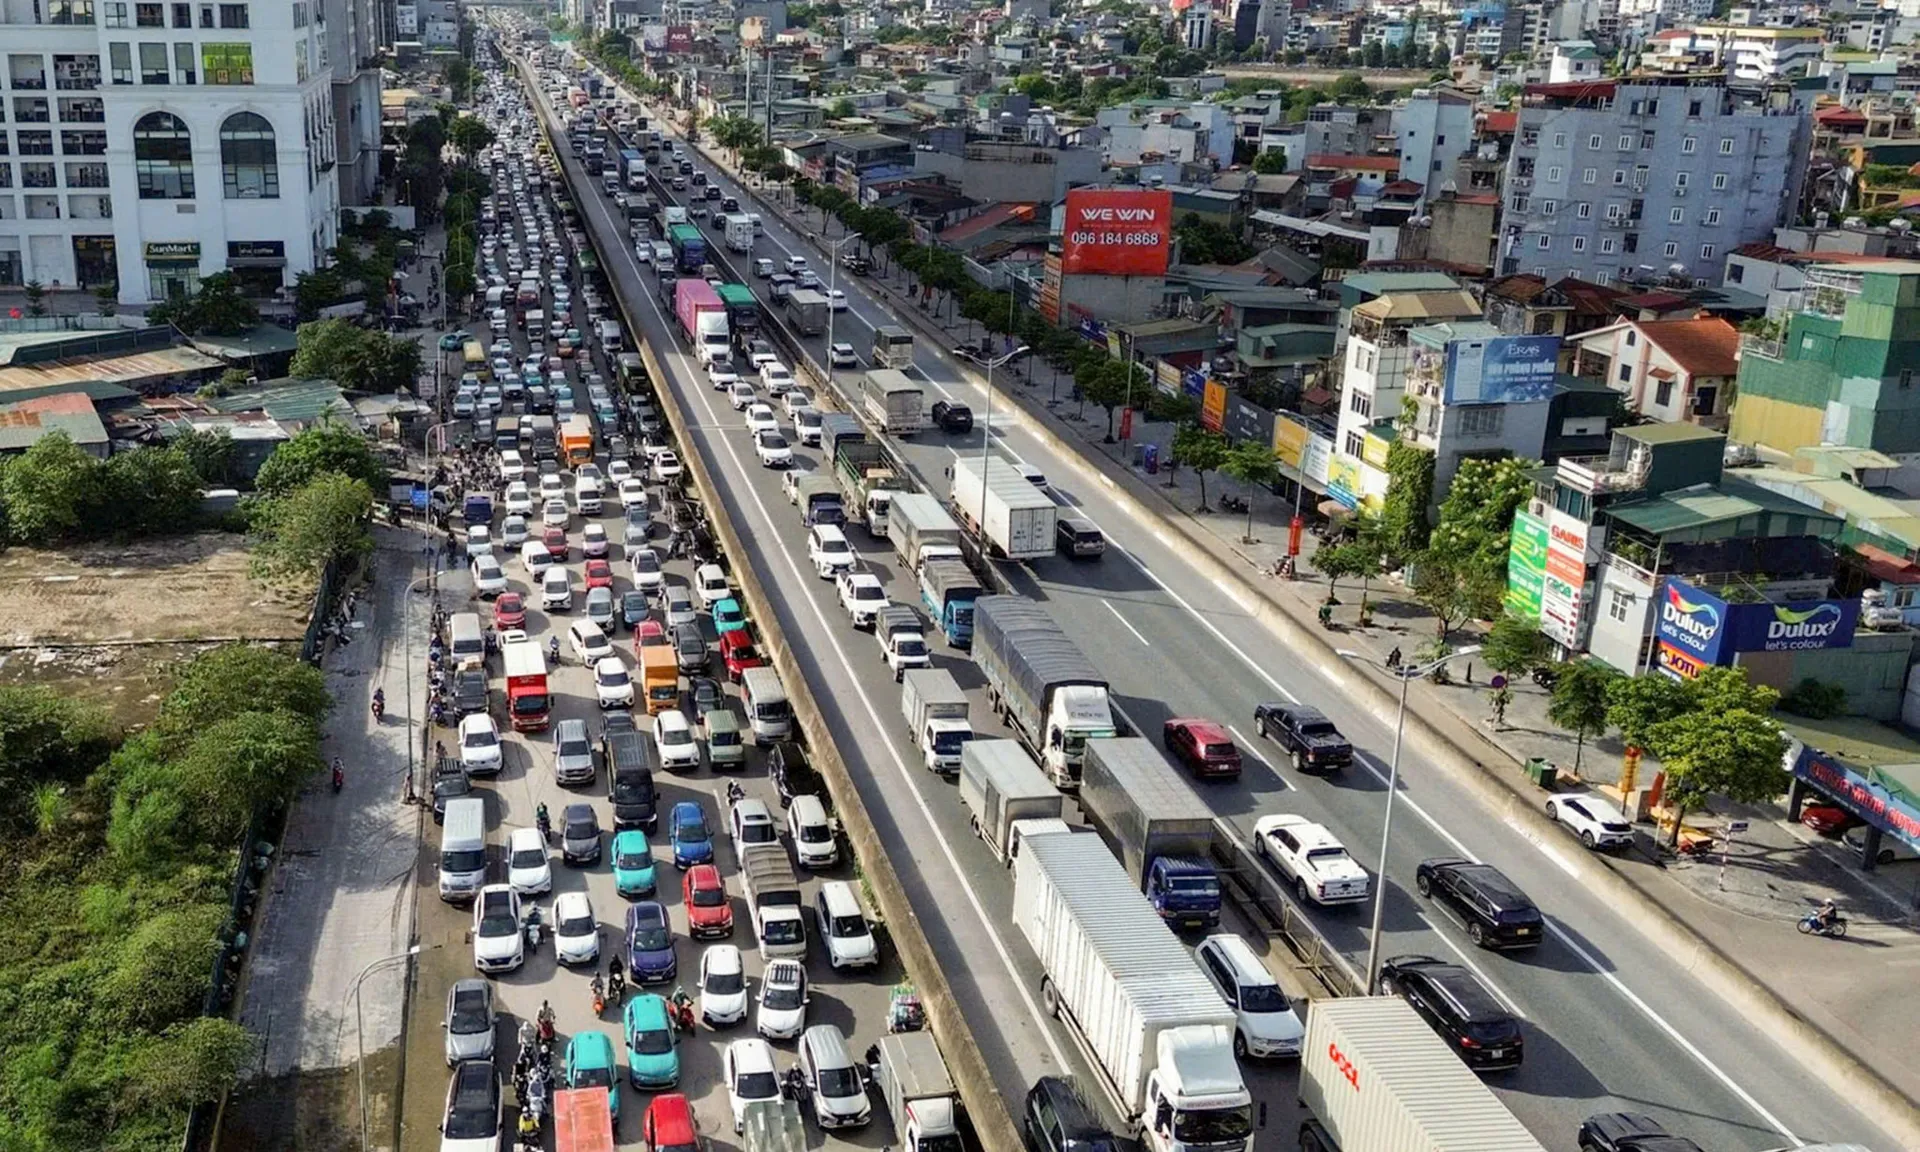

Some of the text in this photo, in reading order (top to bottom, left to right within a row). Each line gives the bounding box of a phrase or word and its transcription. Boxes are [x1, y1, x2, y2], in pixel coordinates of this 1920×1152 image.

[1081, 208, 1155, 220] WE WIN
[1071, 231, 1158, 245] 096 184 6868
[149, 244, 193, 253] SunMart
[1663, 601, 1714, 640] Dulux
[1661, 621, 1708, 652] let's colour
[1767, 621, 1830, 639] Dulux
[1765, 640, 1826, 651] let's colour
[1670, 653, 1701, 679] JOTU
